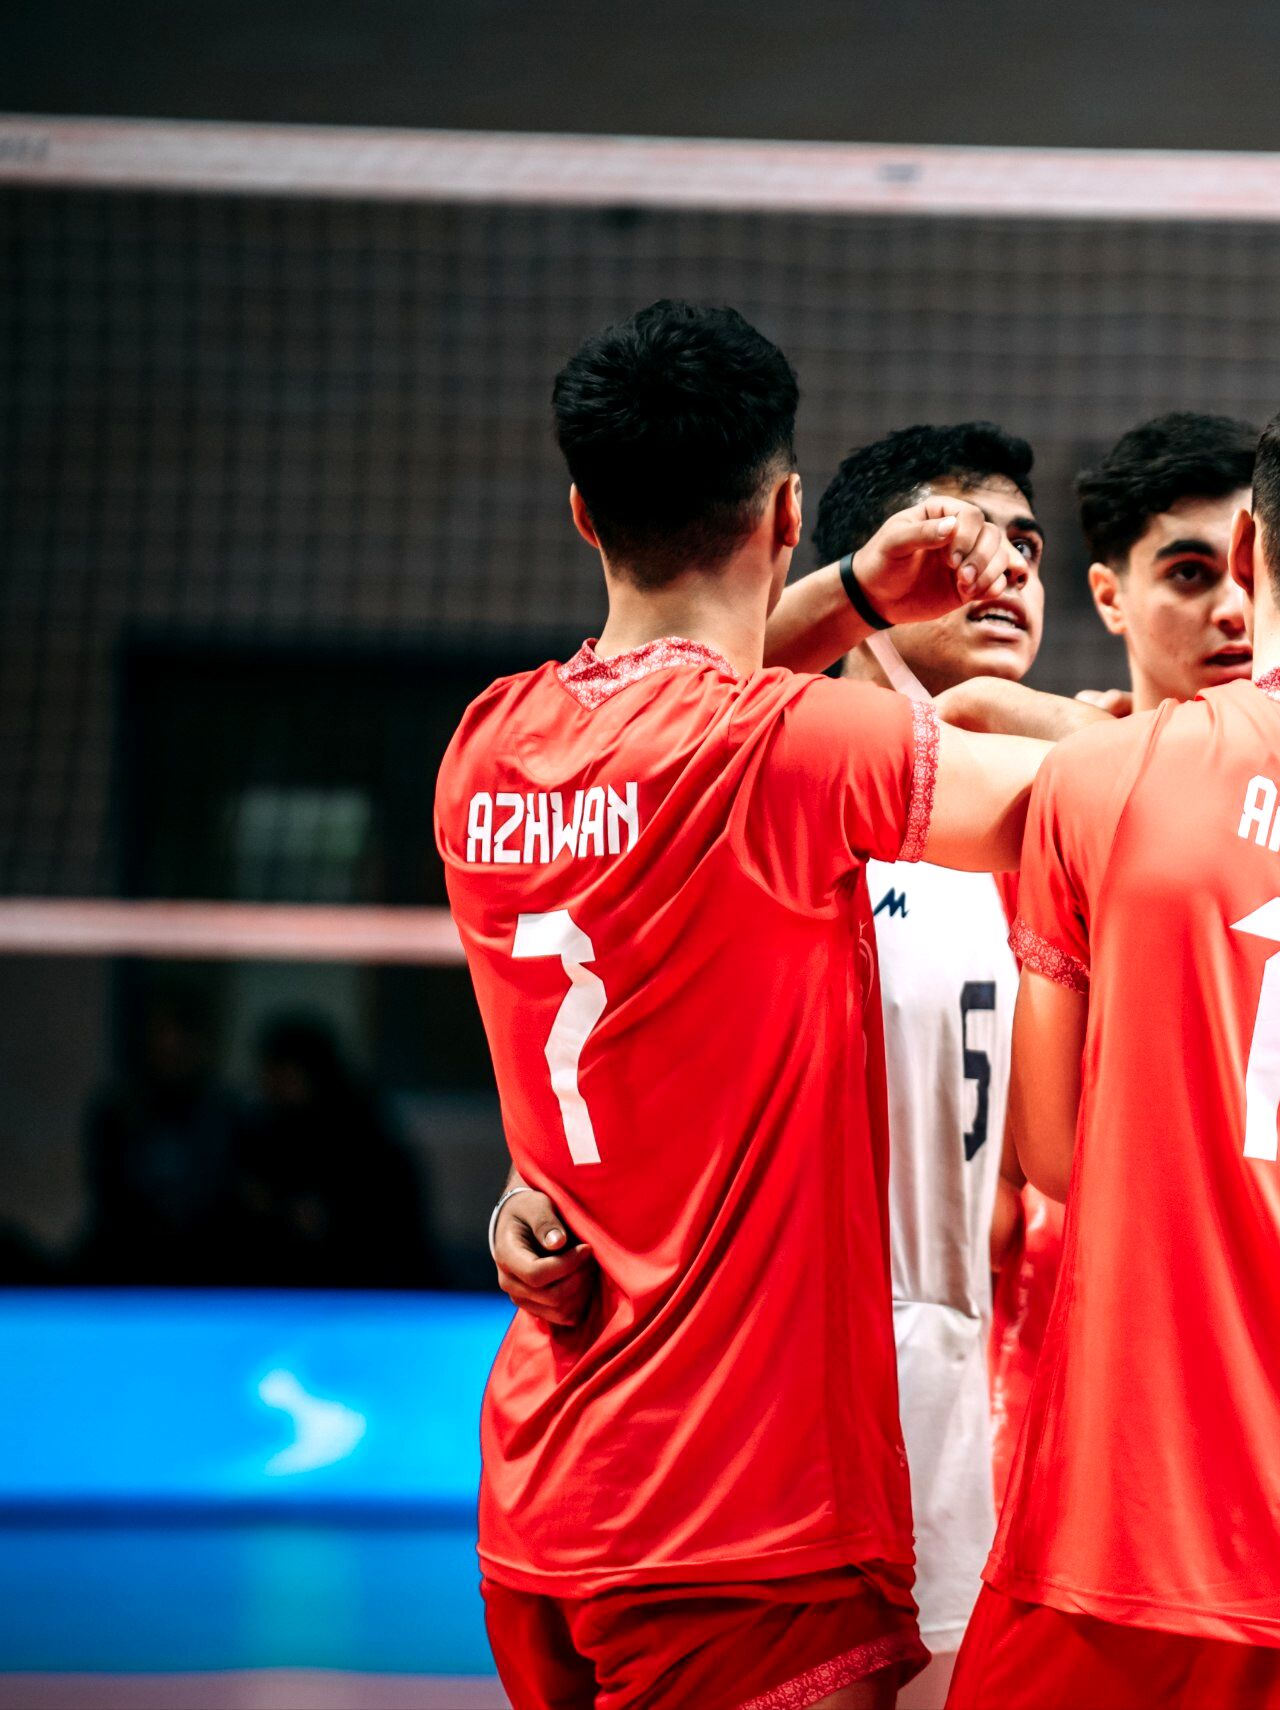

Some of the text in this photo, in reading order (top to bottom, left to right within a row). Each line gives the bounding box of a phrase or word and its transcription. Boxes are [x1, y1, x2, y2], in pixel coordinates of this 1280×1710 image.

[466, 782, 639, 863] AZHWAN
[512, 909, 608, 1165] 7
[960, 981, 997, 1162] 5
